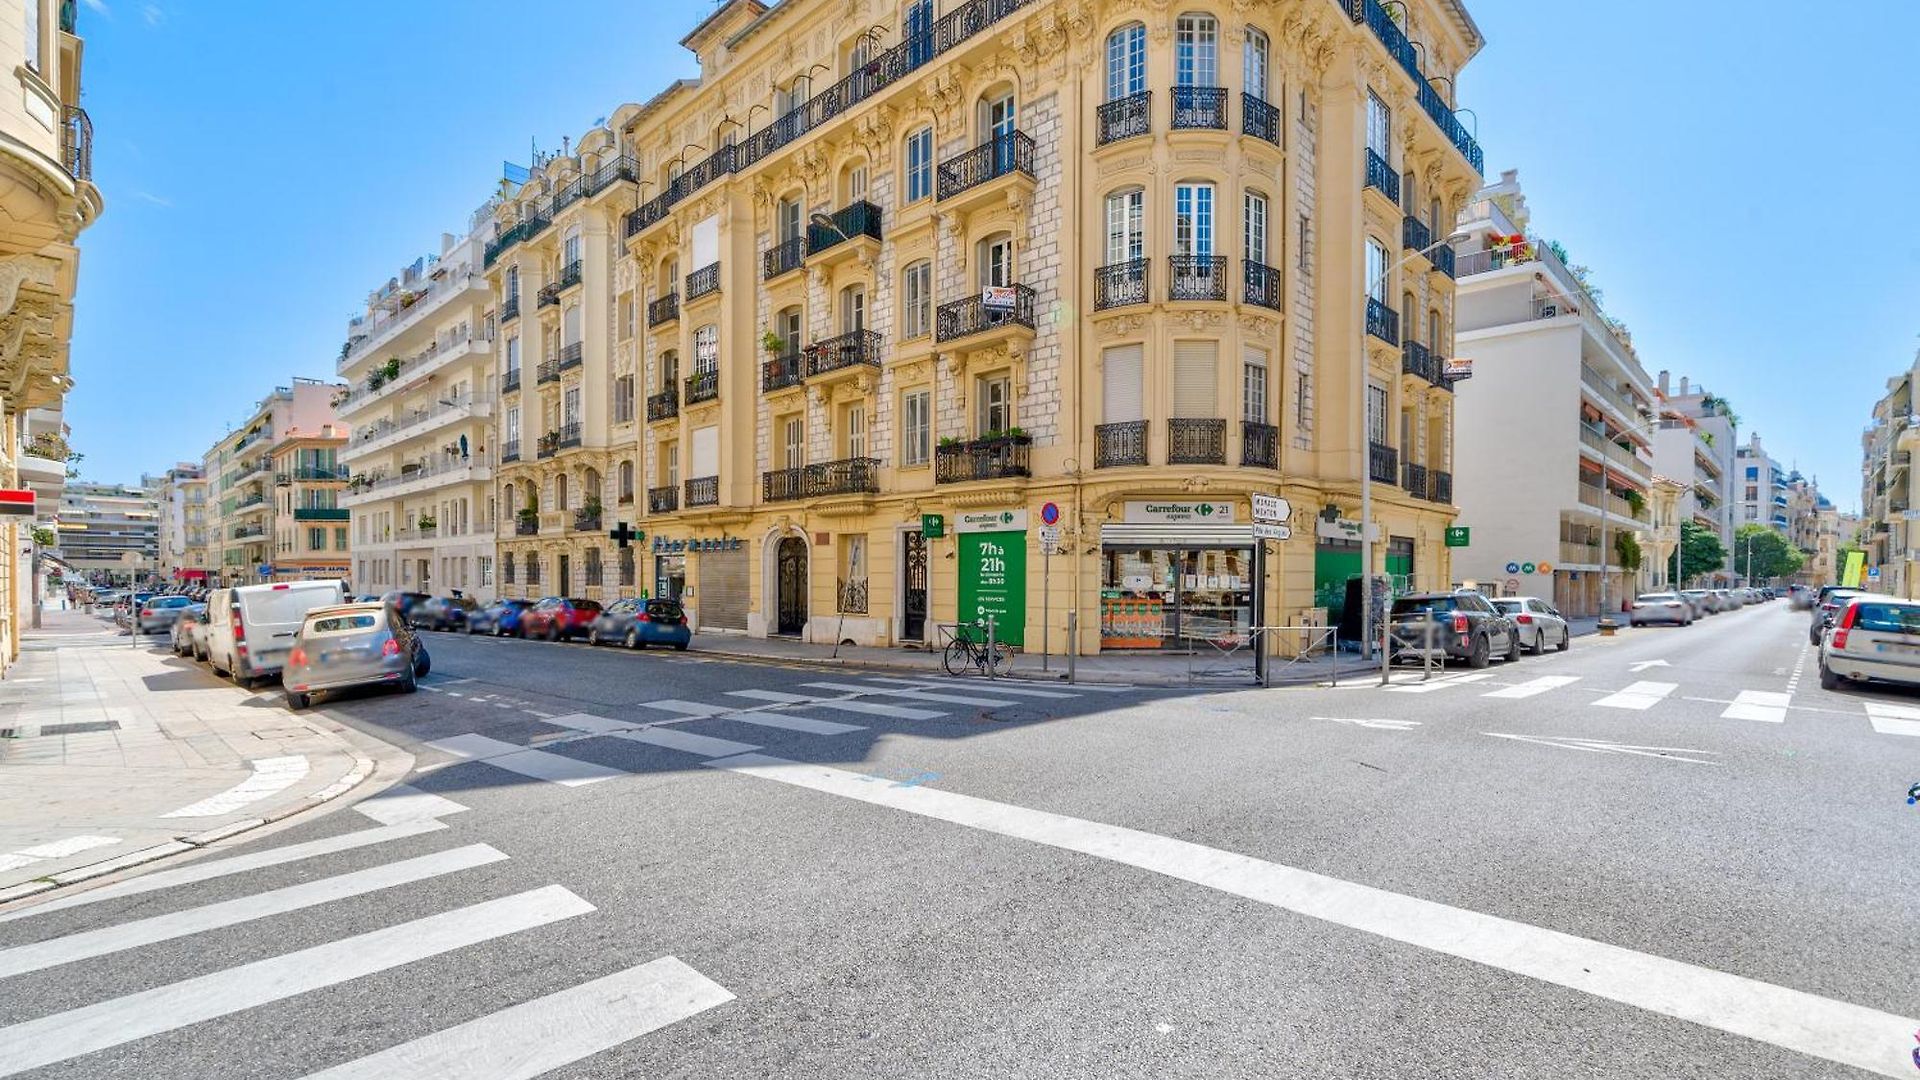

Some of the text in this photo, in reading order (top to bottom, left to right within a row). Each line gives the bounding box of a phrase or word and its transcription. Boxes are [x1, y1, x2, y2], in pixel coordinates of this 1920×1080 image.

[1145, 503, 1191, 513] Carrefour
[964, 514, 997, 523] Carrefour
[979, 541, 997, 555] 7h
[981, 557, 1005, 572] 21h
